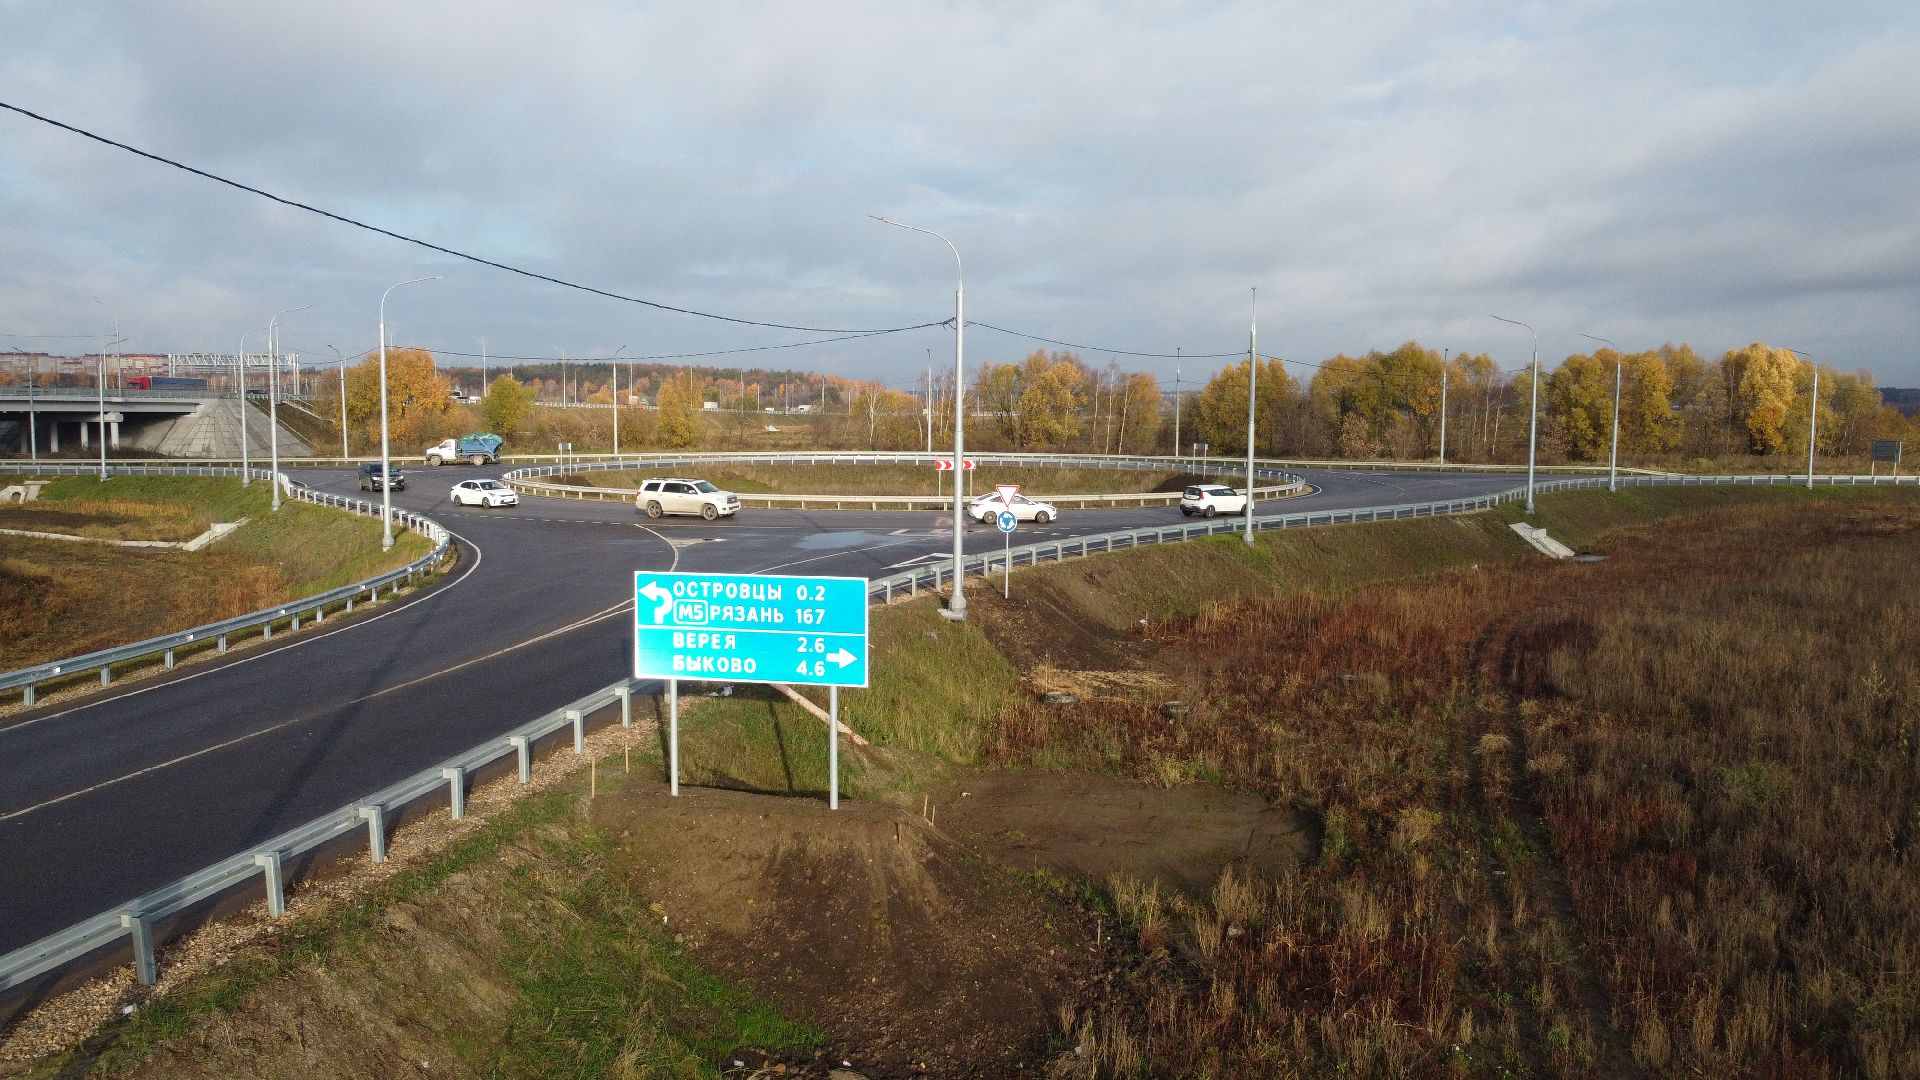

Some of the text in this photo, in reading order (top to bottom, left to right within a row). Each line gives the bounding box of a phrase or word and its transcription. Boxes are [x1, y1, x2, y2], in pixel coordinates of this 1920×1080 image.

[673, 580, 825, 601] ОСТРОВЦЫ 0.2
[709, 605, 784, 623] РЯЗАНЬ
[796, 608, 825, 624] 167
[673, 632, 825, 653] ВЕРЕЯ 2.6
[672, 654, 825, 677] БЫКОВО 4.6
